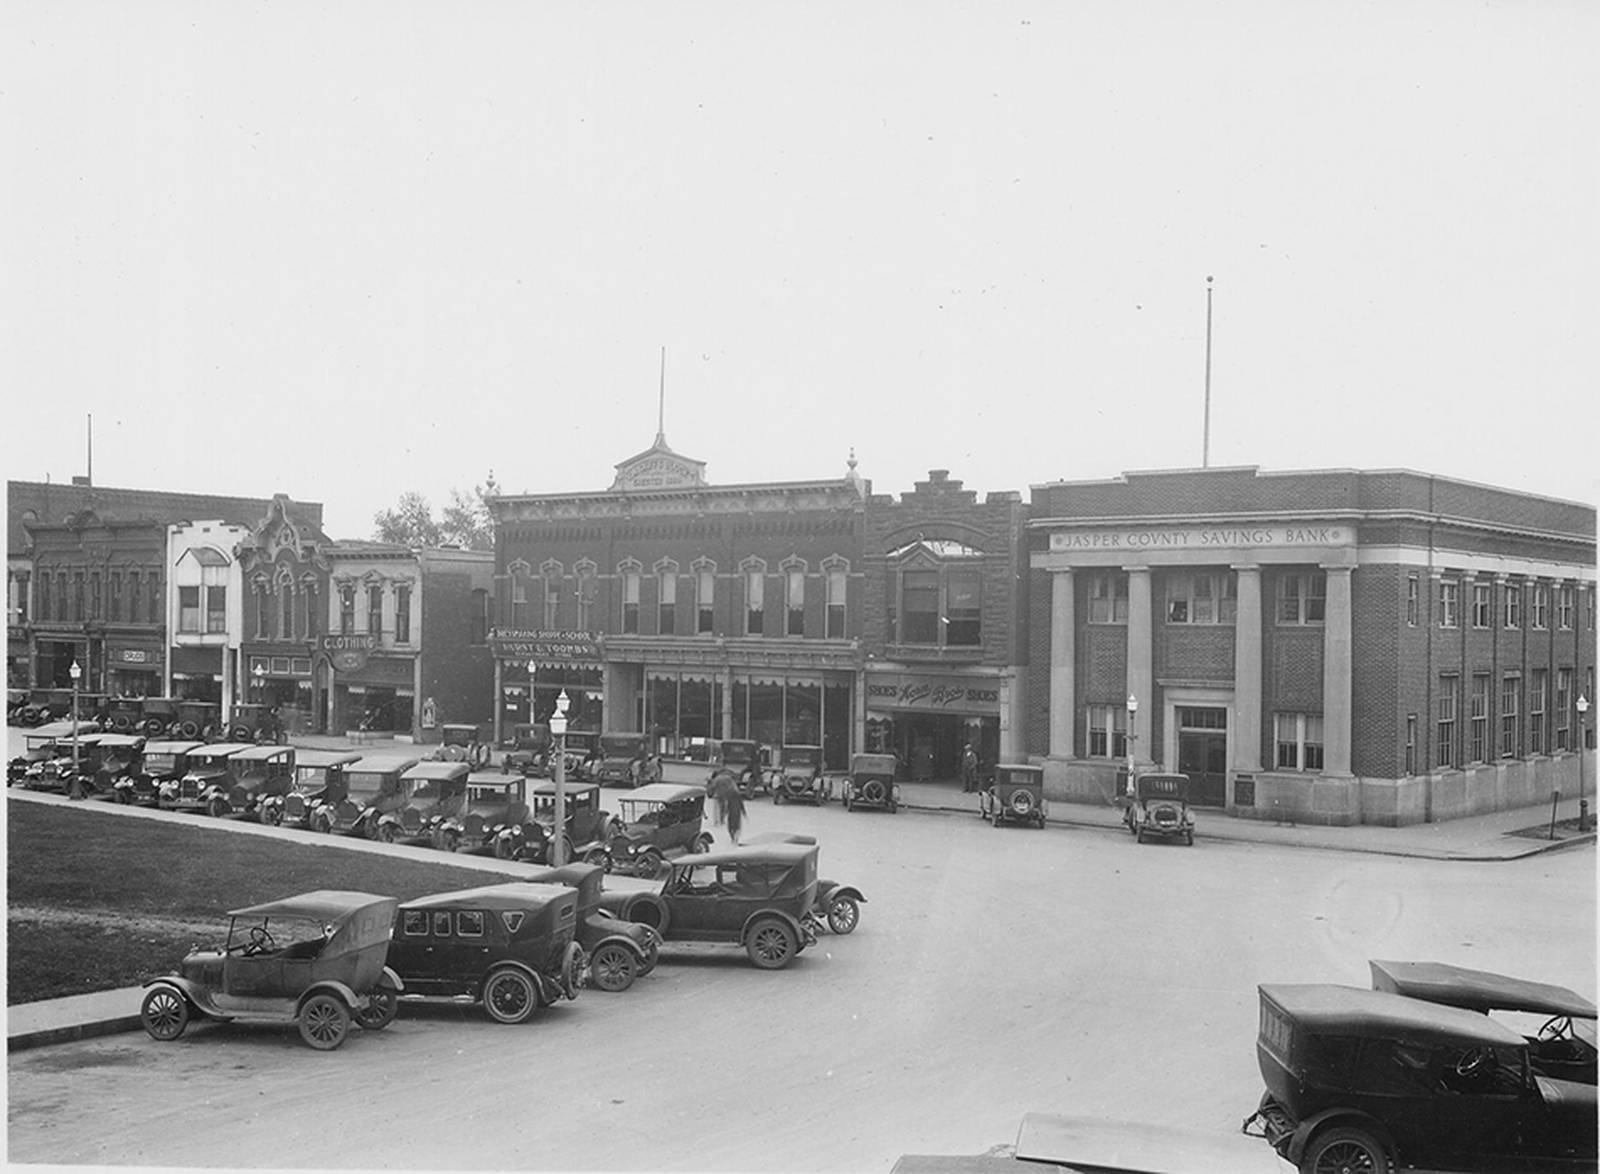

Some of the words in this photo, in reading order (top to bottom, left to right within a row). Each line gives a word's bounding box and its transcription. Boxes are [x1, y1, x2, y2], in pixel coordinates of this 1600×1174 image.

[1066, 534, 1120, 547] JASPER
[1201, 529, 1273, 544] SAVINGS
[1286, 528, 1329, 543] BANK
[324, 636, 375, 649] CLOTHING
[868, 684, 897, 698] SHOES
[966, 688, 999, 702] SHOES
